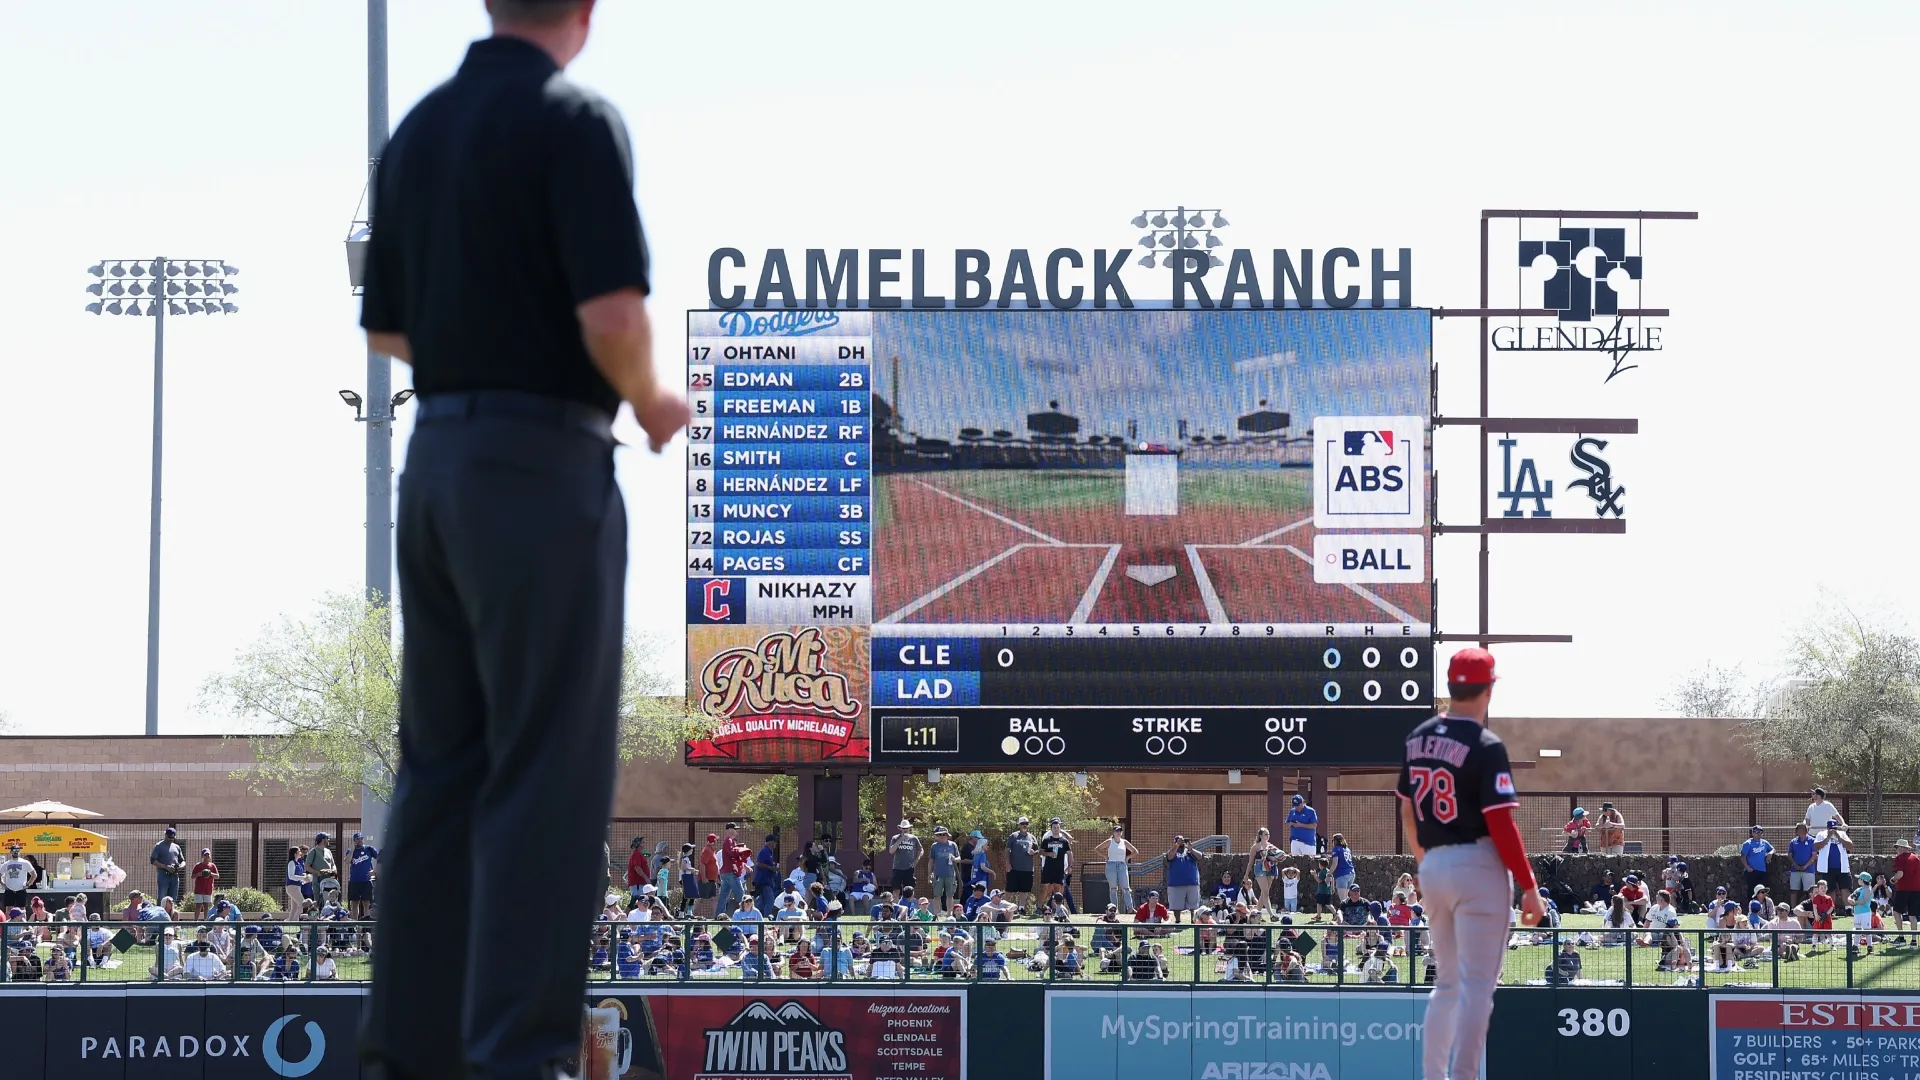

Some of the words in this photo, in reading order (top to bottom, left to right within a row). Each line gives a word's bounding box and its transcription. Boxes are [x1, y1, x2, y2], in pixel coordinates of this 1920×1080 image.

[708, 247, 1134, 309] CAMELBACK
[1172, 247, 1412, 309] RANCH
[719, 311, 840, 337] Dodgers
[693, 346, 711, 360] 17
[724, 345, 796, 360] OHTANI
[838, 346, 865, 360] DH
[691, 373, 712, 387] 25
[723, 372, 793, 387] EDMAN
[839, 373, 863, 387] 2B
[696, 400, 707, 413] 5
[723, 399, 815, 414] FREEMAN
[840, 400, 862, 414] 1B
[691, 427, 712, 440] 37
[723, 420, 828, 440] HERNÁNDEZ
[839, 426, 863, 440] RF
[692, 453, 711, 466] 16
[723, 451, 781, 466] SMITH
[844, 452, 857, 466] C
[696, 479, 707, 492] 8
[723, 473, 828, 492] HERNÁNDEZ
[839, 478, 862, 493] LF
[1334, 465, 1404, 492] ABS
[1497, 438, 1553, 518] LA
[692, 504, 711, 518] 13
[723, 503, 792, 519] MUNCY
[839, 504, 863, 519] 3B
[691, 531, 712, 544] 72
[723, 530, 786, 545] ROJAS
[839, 531, 862, 545] SS
[689, 557, 713, 571] 44
[723, 557, 785, 571] PAGES
[838, 557, 863, 571] CF
[1341, 548, 1411, 570] BALL
[758, 582, 857, 599] NIKHAZY
[703, 578, 731, 621] C
[813, 605, 853, 619] MPH
[1002, 626, 1007, 636] 1
[1032, 626, 1040, 636] 2
[1065, 626, 1074, 636] 3
[1098, 626, 1108, 636] 4
[1132, 626, 1141, 636] 5
[1165, 626, 1174, 636] 6
[1199, 626, 1207, 636] 7
[1232, 626, 1240, 636] 8
[1266, 626, 1274, 636] 9
[1325, 625, 1335, 636] R
[1364, 625, 1374, 636] H
[1402, 625, 1411, 636] E
[899, 644, 950, 665] CLE
[997, 648, 1014, 668] 0
[1323, 647, 1341, 669] 0
[1362, 646, 1381, 669] 0
[1400, 646, 1419, 669] 0
[897, 679, 953, 699] LAD
[1323, 680, 1342, 701] 0
[1363, 679, 1382, 701] 0
[1401, 679, 1420, 701] 0
[713, 723, 746, 738] LOCAL
[745, 719, 785, 732] QUALITY
[787, 719, 847, 738] MICHELADAS
[1009, 717, 1061, 733] BALL
[1132, 717, 1203, 733] STRIKE
[1264, 717, 1307, 733] OUT
[904, 727, 937, 746] 1:11
[1409, 766, 1458, 824] 78
[867, 1002, 904, 1016] Arizona
[907, 1002, 951, 1014] Locations
[887, 1019, 933, 1028] PHOENIX
[1557, 1007, 1630, 1037] 380
[883, 1033, 937, 1042] GLENDALE
[1733, 1035, 1742, 1047] 7
[1747, 1035, 1822, 1048] BUILDERS
[81, 1035, 250, 1059] PARADOX
[705, 1031, 767, 1071] TWIN
[774, 1031, 847, 1071] PEAKS
[877, 1047, 943, 1057] SCOTTSDALE
[892, 1062, 926, 1071] TEMPE
[1733, 1052, 1777, 1066] GOLF
[1801, 1054, 1828, 1067] 65+
[1833, 1054, 1880, 1067] MILES
[1883, 1055, 1896, 1063] OF
[1200, 1061, 1332, 1080] ARIZONA
